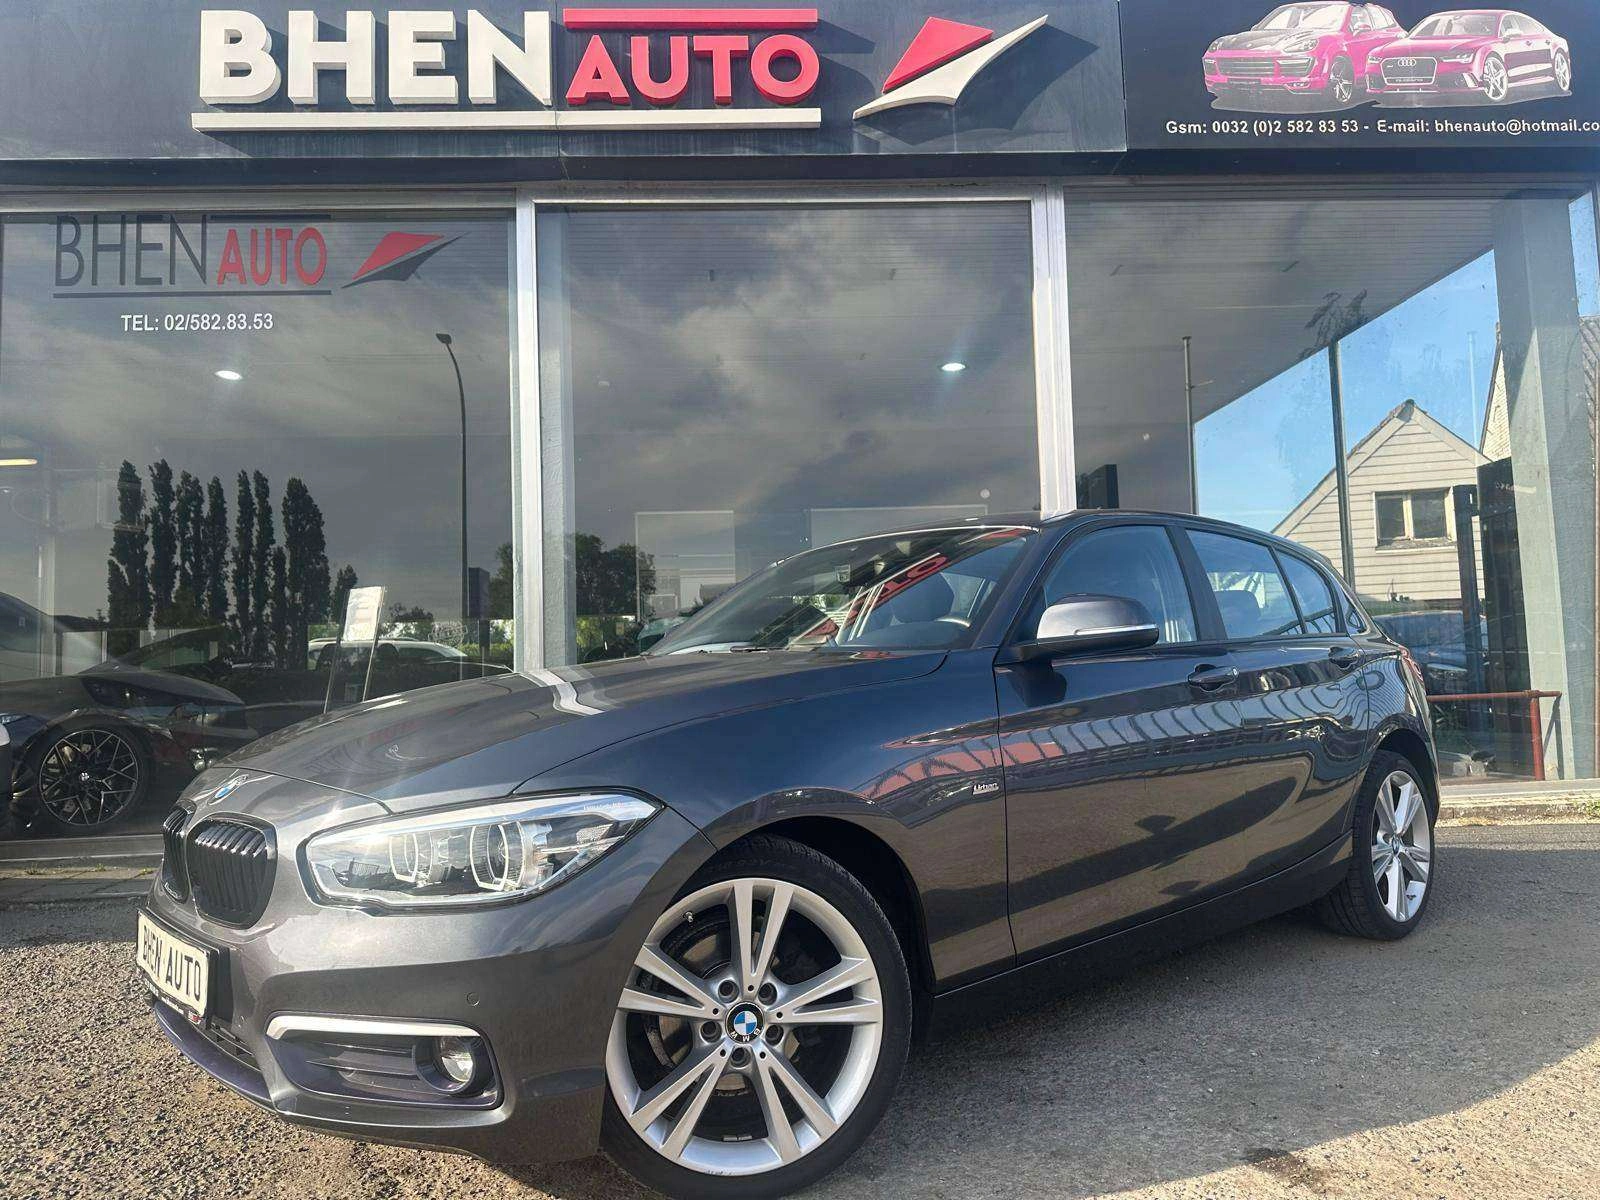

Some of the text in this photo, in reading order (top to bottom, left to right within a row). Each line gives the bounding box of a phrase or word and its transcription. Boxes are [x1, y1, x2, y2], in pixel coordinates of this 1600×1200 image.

[200, 9, 820, 106] BHEN AUTO
[1166, 120, 1207, 134] Gsm:
[1212, 120, 1249, 133] 0032
[1253, 119, 1282, 136] (0)2
[1287, 120, 1314, 133] 582
[1318, 120, 1336, 133] 83
[1341, 119, 1359, 132] 53
[1377, 119, 1430, 132] E-mail:
[55, 214, 328, 287] BHEN AUTO
[121, 313, 274, 332] TEL: 02/582.83.53
[142, 924, 202, 1002] BHEN AUTO
